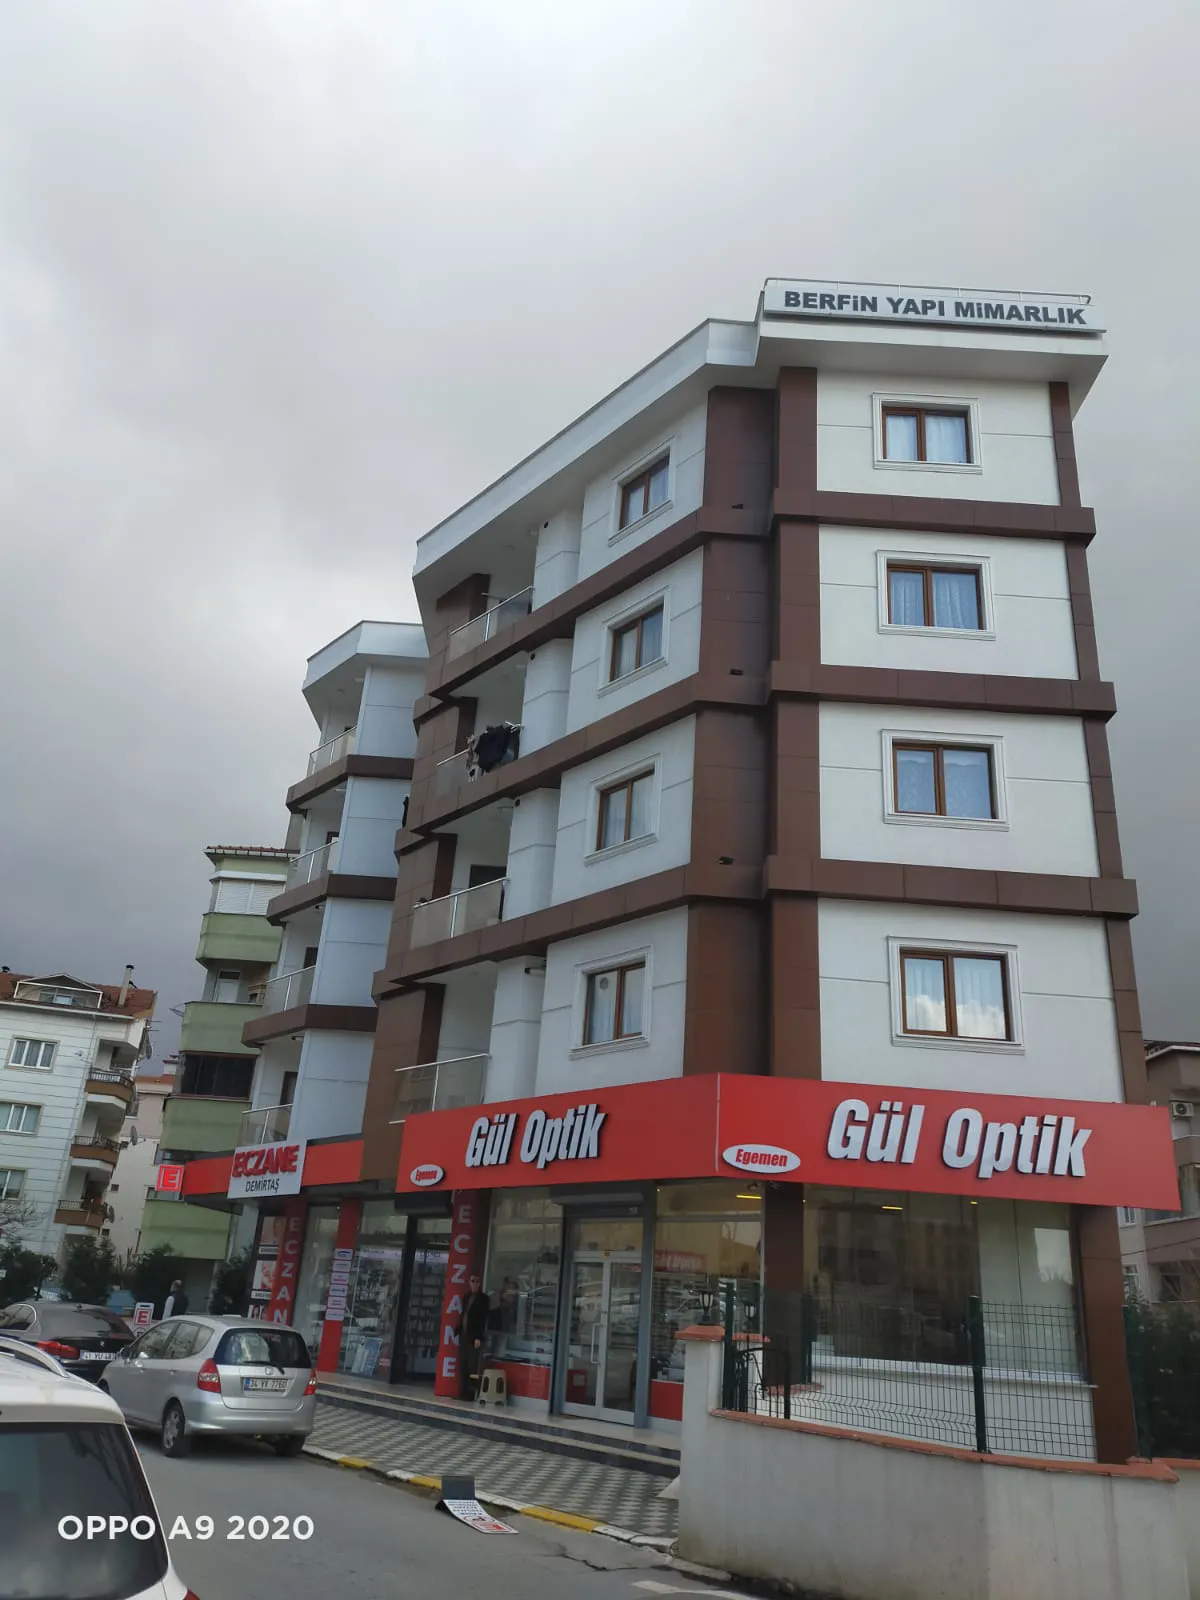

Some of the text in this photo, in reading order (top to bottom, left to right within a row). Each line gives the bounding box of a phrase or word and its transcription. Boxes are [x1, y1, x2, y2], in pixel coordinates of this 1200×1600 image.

[887, 297, 945, 317] YAPI
[465, 1104, 606, 1168] Gül Optik
[827, 1098, 1092, 1179] Gül Optik
[232, 1144, 300, 1178] ECZANE
[735, 1148, 788, 1168] Egemen
